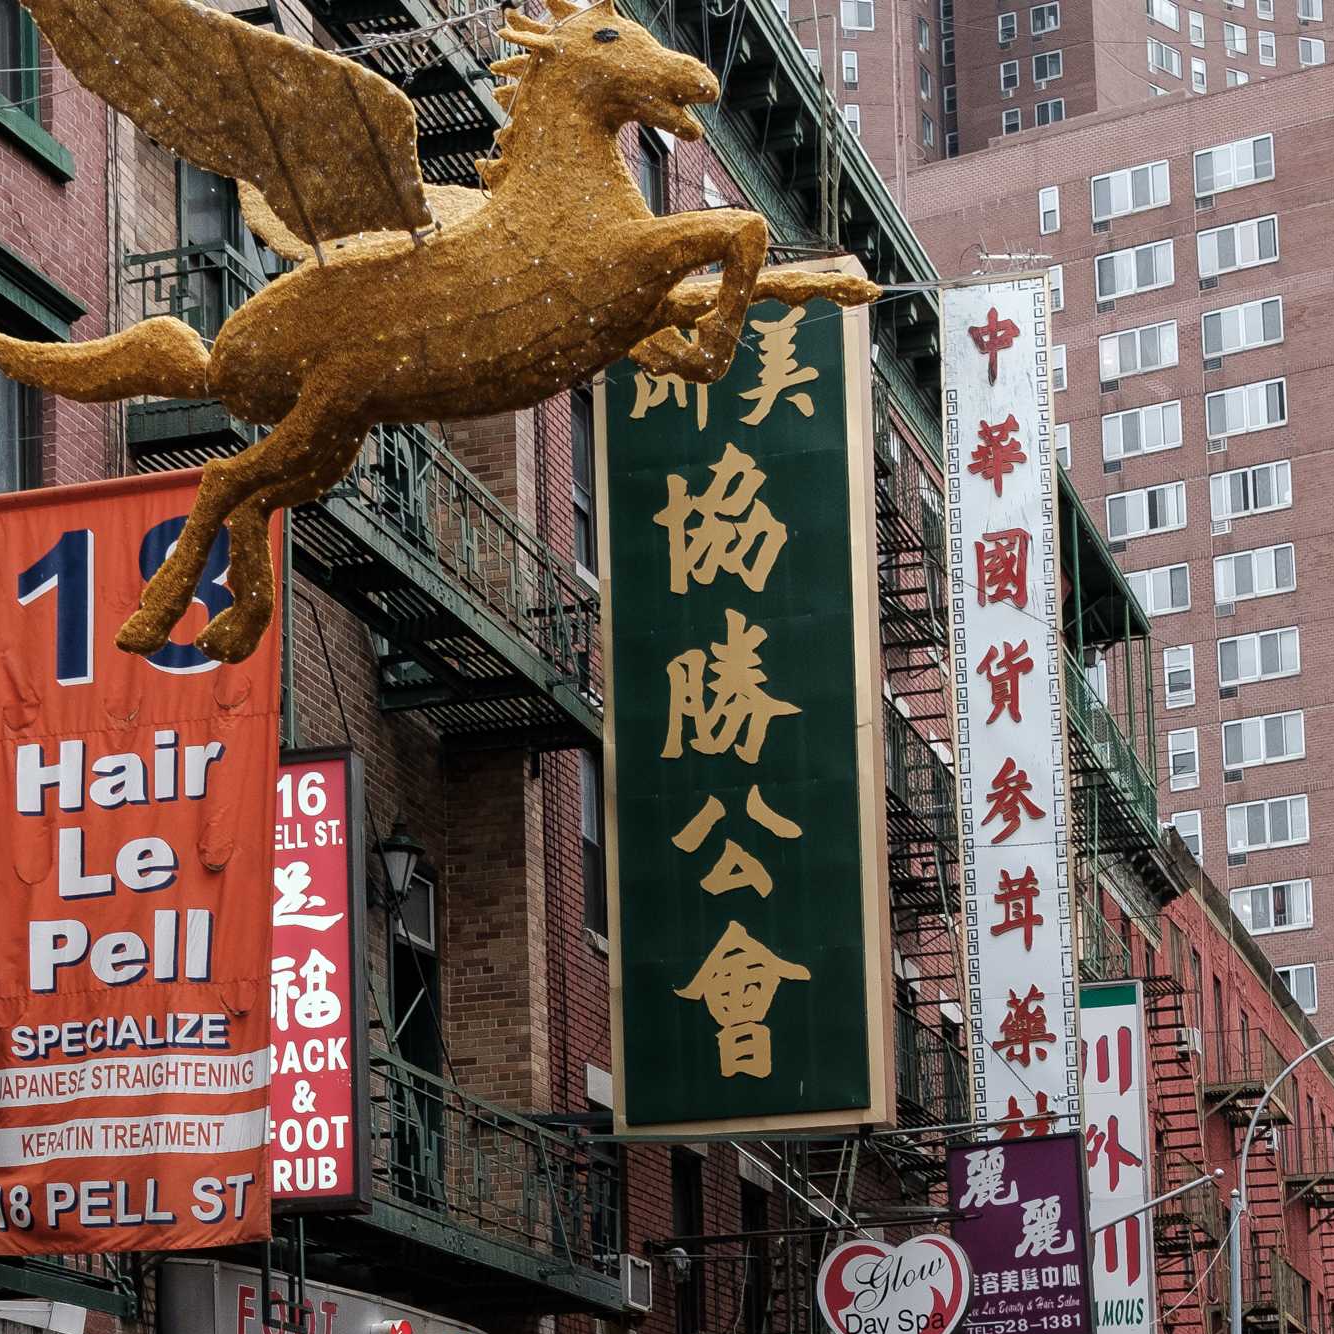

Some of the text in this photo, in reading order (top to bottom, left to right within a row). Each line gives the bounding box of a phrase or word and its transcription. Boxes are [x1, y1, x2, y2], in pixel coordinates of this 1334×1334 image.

[16, 730, 224, 816] Hair
[277, 772, 327, 818] 16
[275, 820, 343, 850] ELL ST.
[58, 827, 178, 901] Le
[29, 908, 214, 994] Pell
[11, 1012, 230, 1058] SPECIALIZE
[91, 1060, 255, 1094] STRAIGHTENING
[292, 1079, 317, 1114] &
[21, 1120, 224, 1160] KERATIN TREATMENT
[273, 1157, 338, 1192] RUB
[46, 1179, 175, 1228] PELL
[191, 1173, 255, 1222] ST
[854, 1254, 946, 1315] Glow
[998, 1300, 1024, 1316] Beauty
[1035, 1296, 1055, 1310] Hair
[1057, 1294, 1080, 1309] Salon
[1096, 1297, 1144, 1328] MOUS
